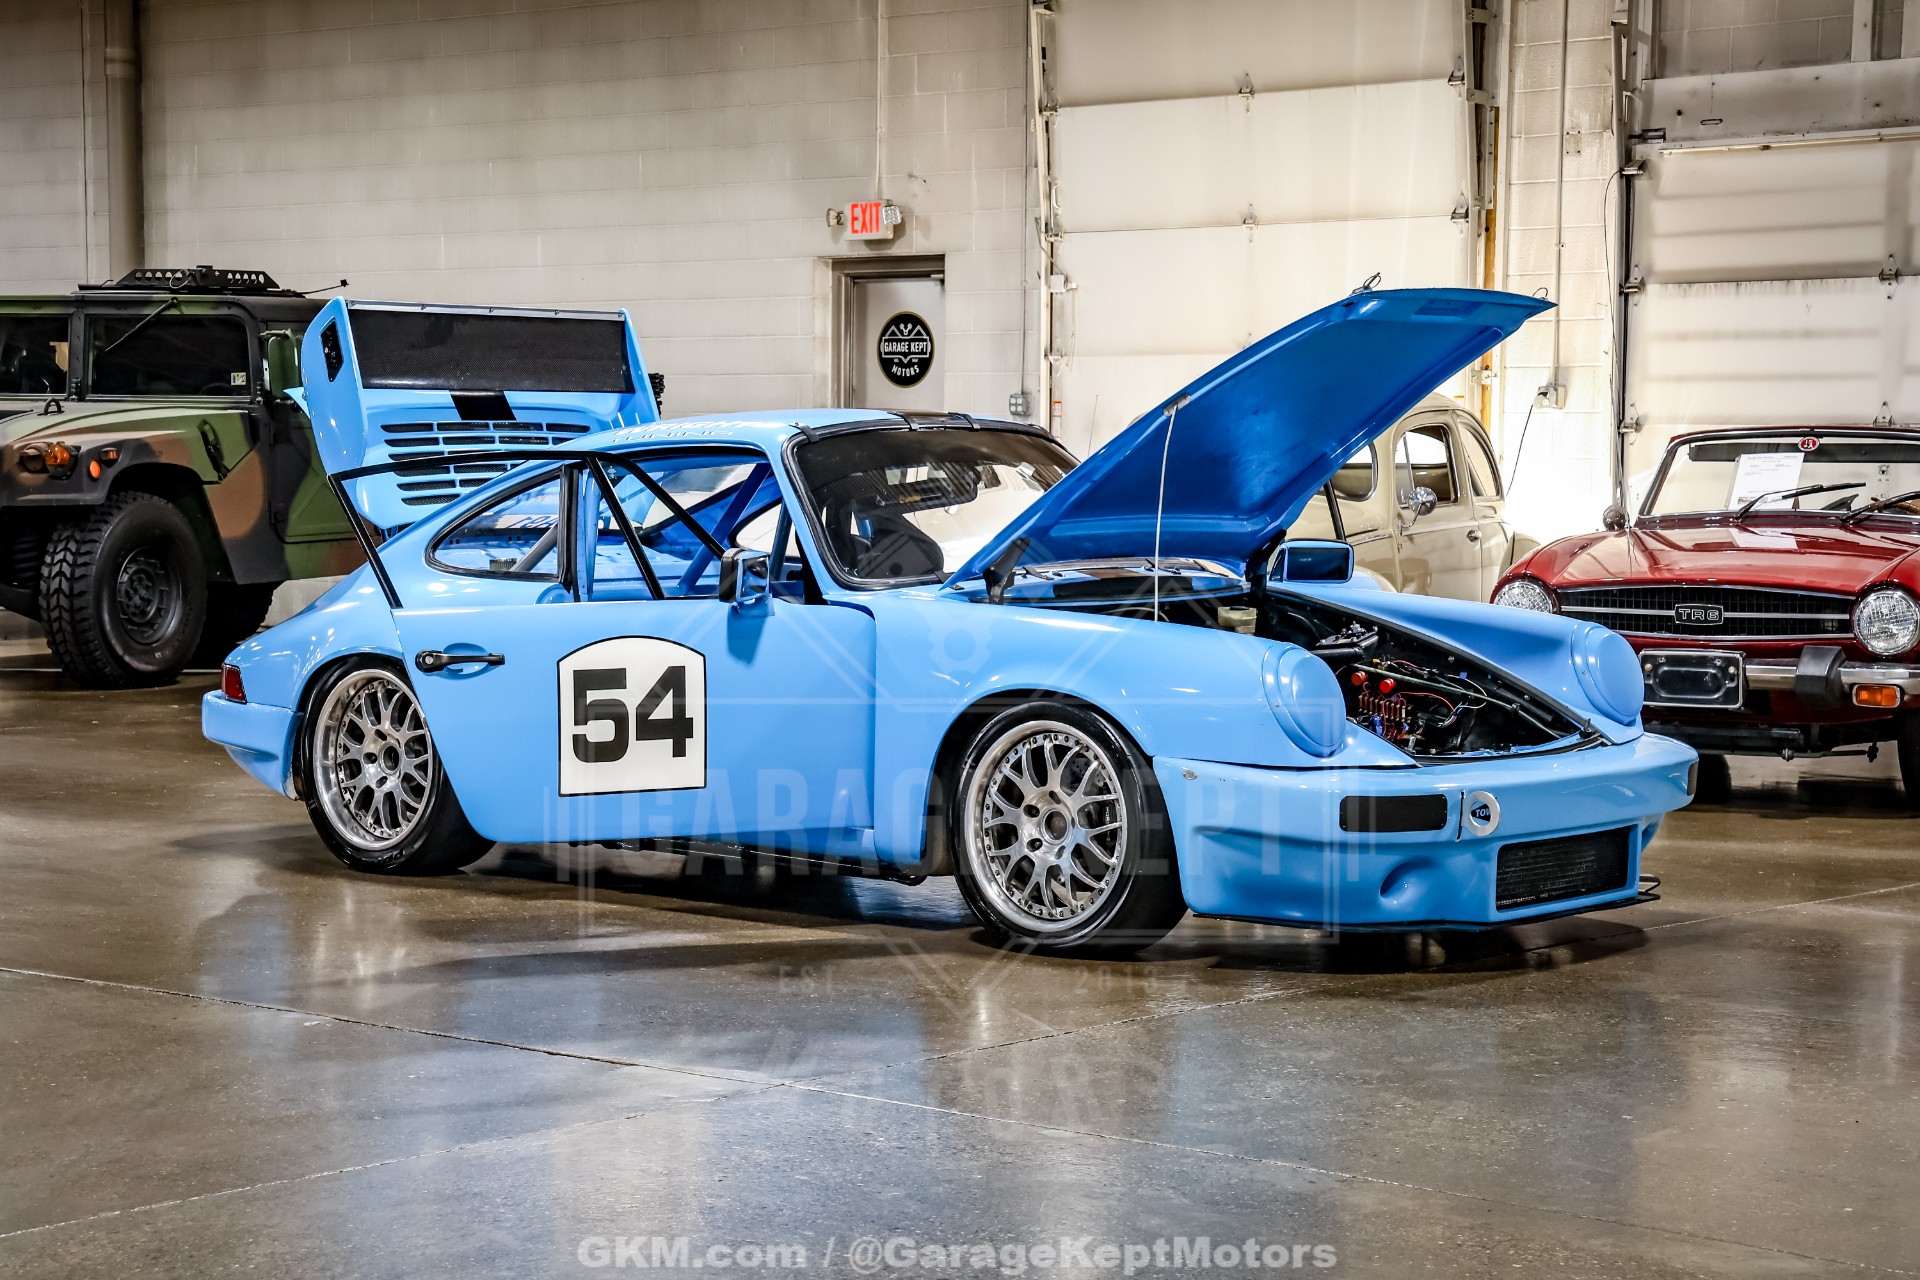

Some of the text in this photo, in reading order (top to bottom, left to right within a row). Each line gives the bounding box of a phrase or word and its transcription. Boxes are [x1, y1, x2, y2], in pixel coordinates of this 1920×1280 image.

[851, 202, 882, 234] EXIT
[884, 342, 927, 352] GARAGE KEPT
[892, 364, 919, 377] MOTORS
[1679, 608, 1719, 620] TR6
[573, 666, 694, 763] 54
